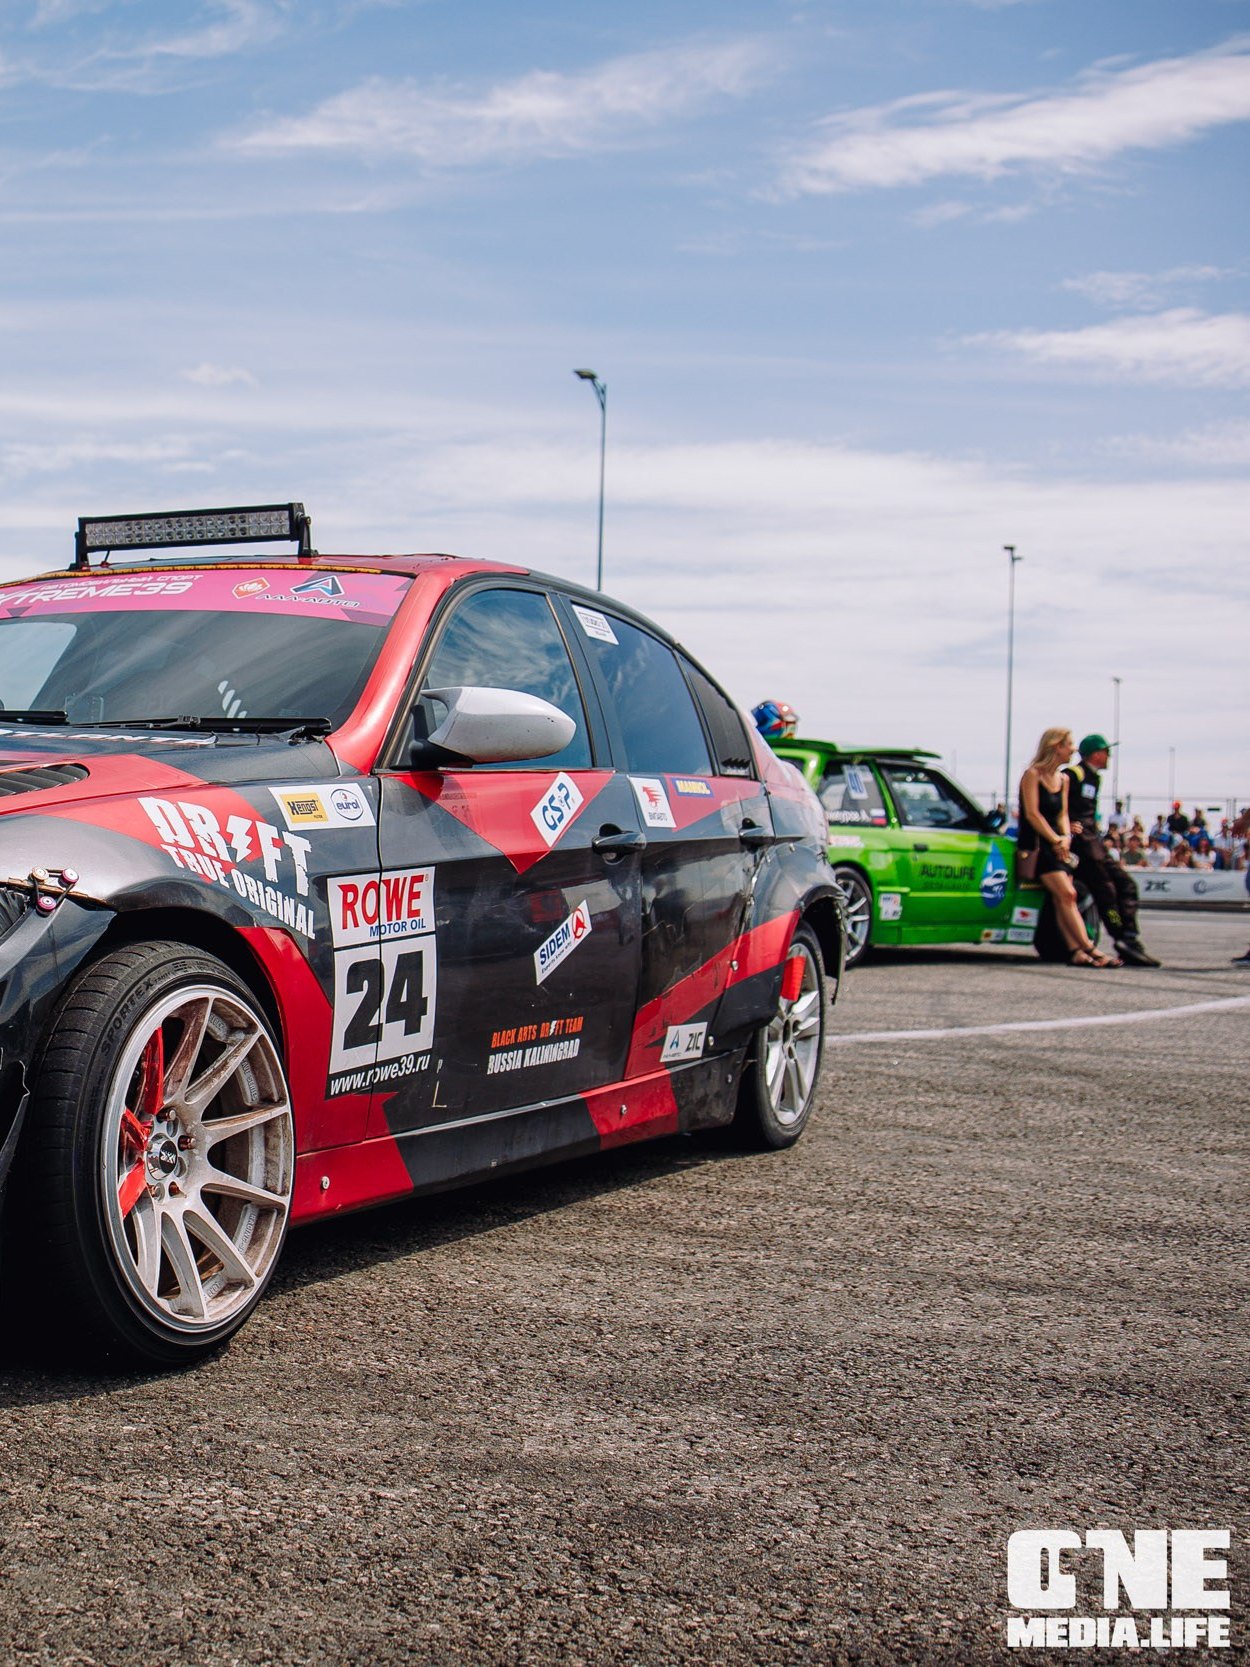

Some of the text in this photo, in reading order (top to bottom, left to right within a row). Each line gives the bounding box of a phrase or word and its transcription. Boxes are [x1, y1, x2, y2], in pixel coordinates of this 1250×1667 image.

[157, 574, 204, 582] СПОРТ
[287, 799, 319, 816] Hengst
[336, 799, 361, 811] eurol
[160, 843, 316, 940] TRUE ORIGINAL
[337, 874, 425, 930] ROWE
[369, 918, 427, 938] MOTOR OIL
[539, 922, 571, 966] SIDEM
[100, 977, 154, 1057] SPORTEX
[343, 950, 429, 1051] 24
[491, 1027, 515, 1049] BLACK
[517, 1024, 537, 1042] ARTS
[565, 1016, 583, 1035] TEAM
[685, 1031, 703, 1053] ZIC
[330, 1053, 431, 1096] www.rowe39.ru
[487, 1038, 581, 1075] RUSSIA KALININGRAD
